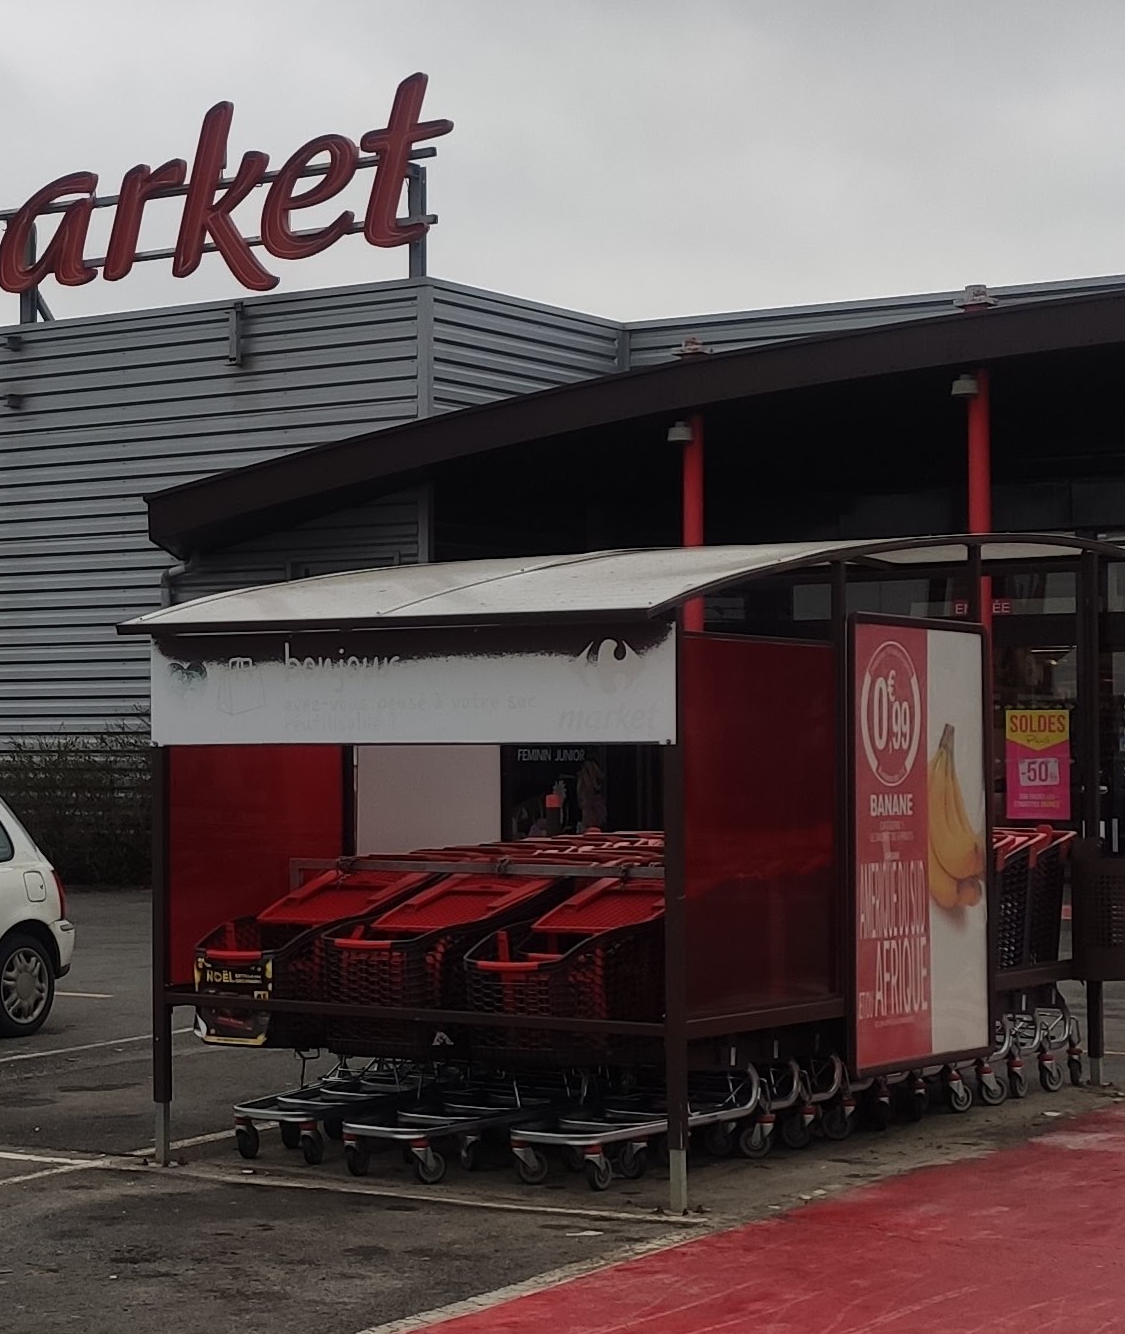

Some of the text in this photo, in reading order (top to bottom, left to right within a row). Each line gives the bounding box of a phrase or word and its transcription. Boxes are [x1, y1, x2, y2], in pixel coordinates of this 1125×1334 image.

[1010, 714, 1065, 733] SOLDES
[555, 749, 585, 761] JUNIOR
[870, 793, 913, 816] BANANE
[206, 969, 236, 983] NOËL
[874, 937, 928, 1017] AFRIQUE
